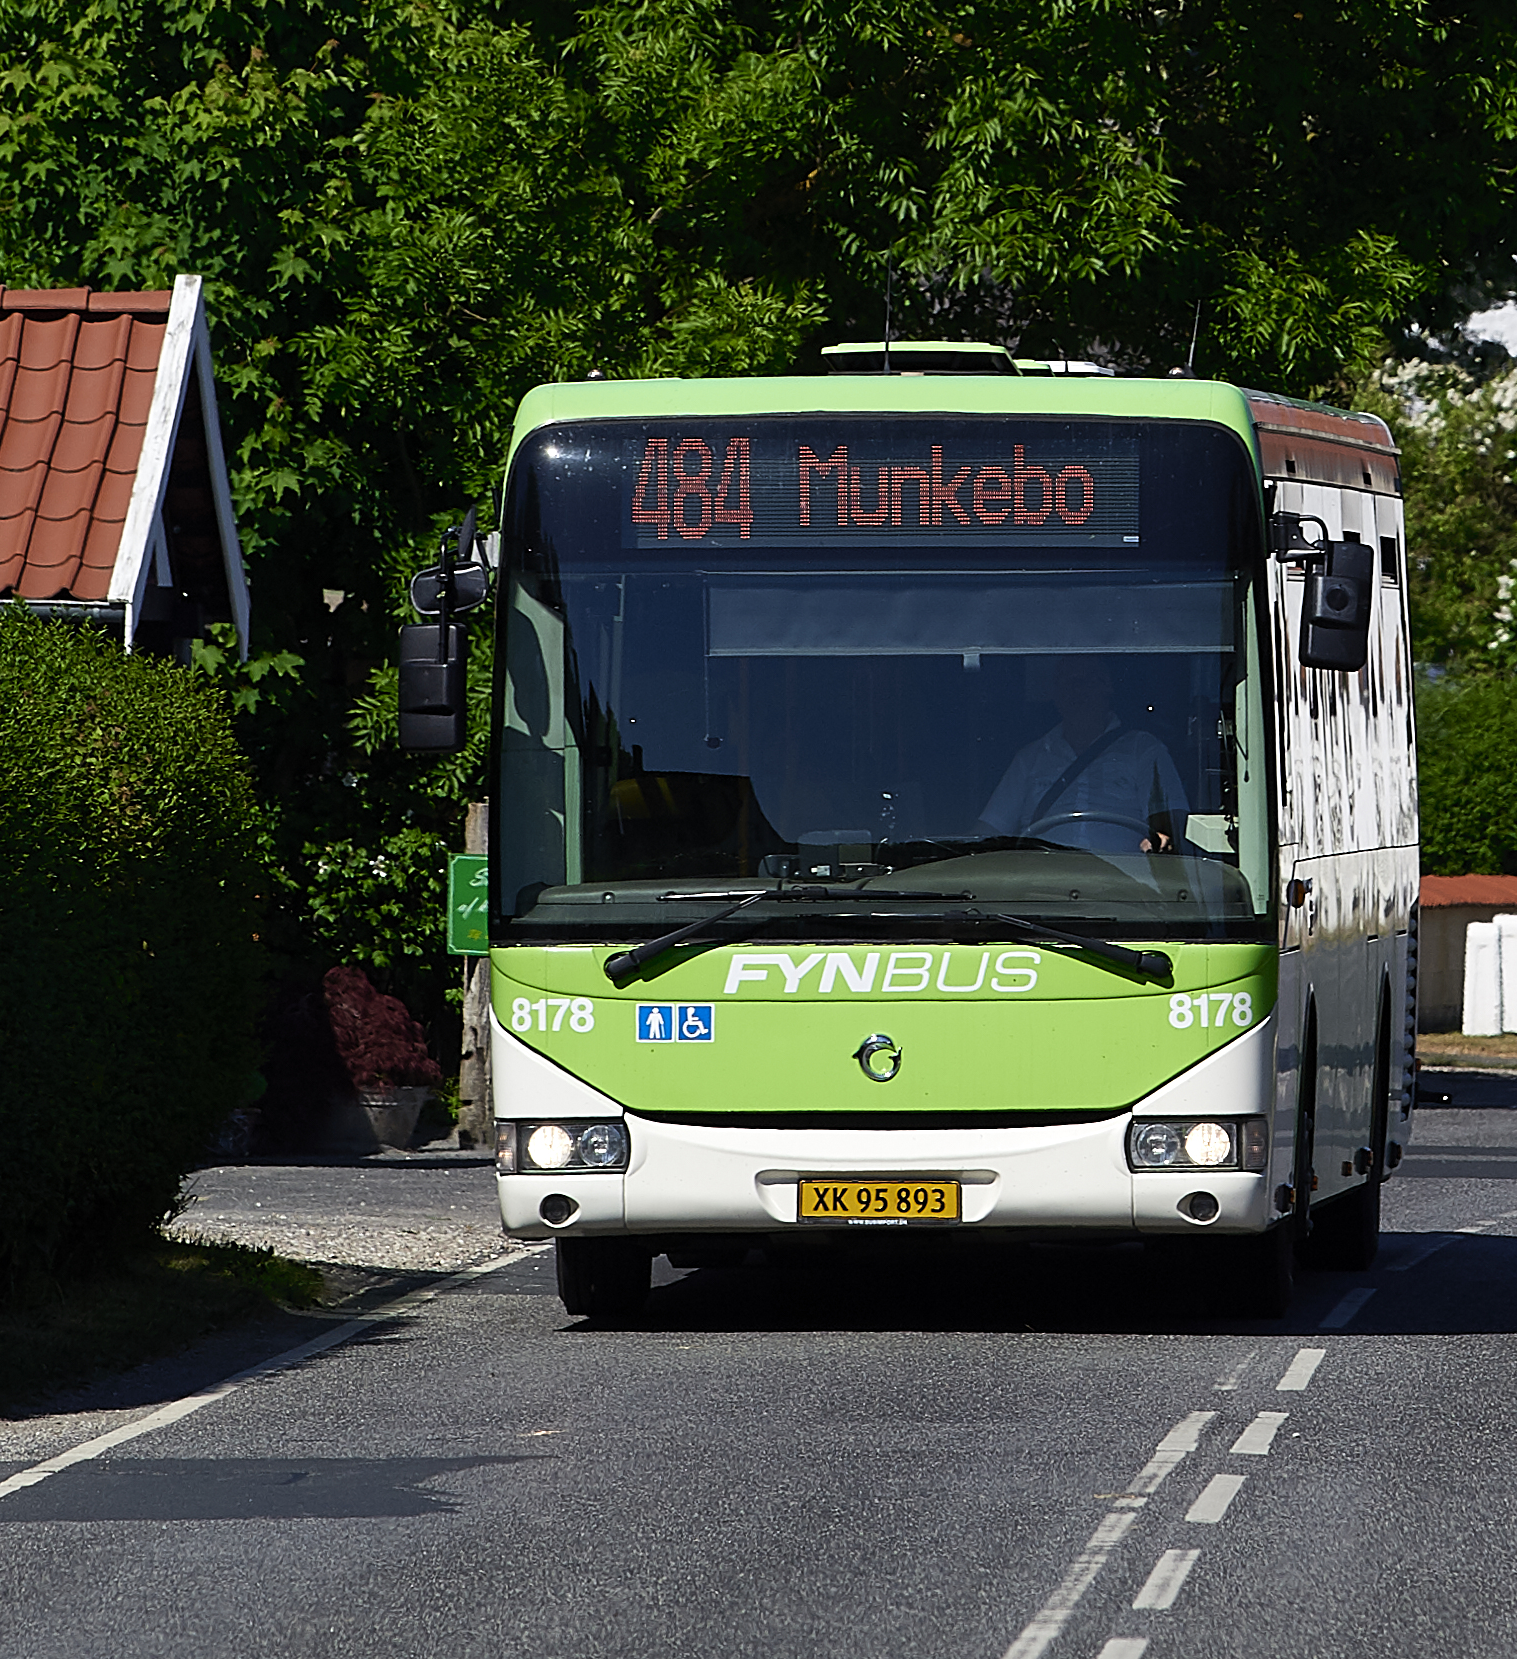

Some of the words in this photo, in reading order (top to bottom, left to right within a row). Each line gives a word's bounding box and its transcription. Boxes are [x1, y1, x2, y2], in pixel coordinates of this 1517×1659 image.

[632, 438, 753, 539] 484
[800, 445, 1094, 525] Munkebo
[723, 952, 1041, 994] FYNBUS
[512, 997, 595, 1033] 8178
[1169, 992, 1253, 1029] 8178
[813, 1187, 849, 1212] XK
[856, 1187, 888, 1213] 95
[896, 1187, 945, 1213] 893
